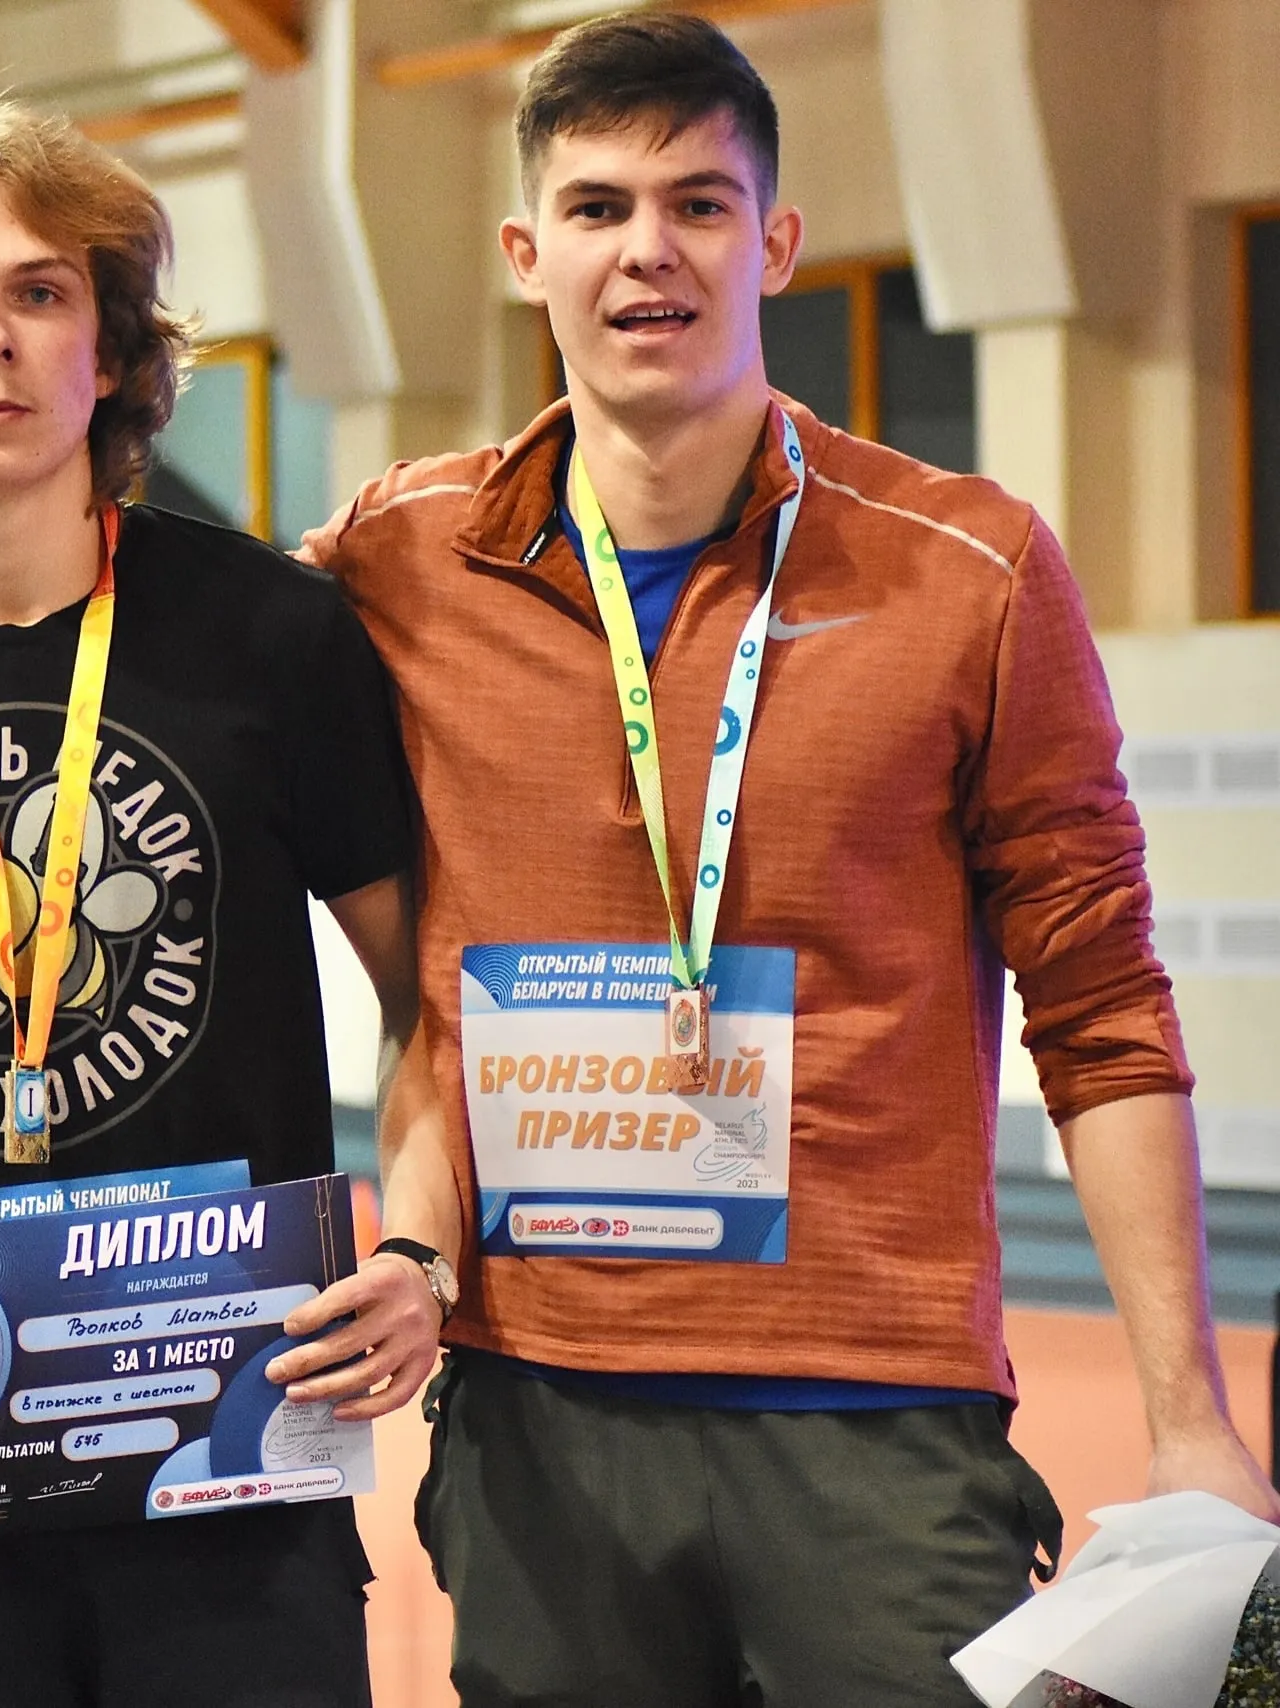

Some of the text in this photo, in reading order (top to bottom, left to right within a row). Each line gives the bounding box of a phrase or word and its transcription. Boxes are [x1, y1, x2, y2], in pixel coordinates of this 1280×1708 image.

[53, 739, 203, 883] ЕДОК
[518, 951, 606, 975] ОТКРЫТЫЙ
[512, 981, 588, 1000] БЕЛАРУСИ
[591, 981, 602, 1000] В
[0, 934, 204, 1134] ОЛОДОК
[516, 1110, 702, 1152] ПРИЗЕР
[713, 1152, 766, 1160] CHAMPIONSHIPS
[70, 1180, 171, 1210] ЧЕМПИОНАТ
[736, 1180, 759, 1189] 2023
[59, 1200, 267, 1280] ДИПЛОМ
[632, 1225, 715, 1236] БАНК ДАБРАБЫТ
[126, 1272, 209, 1294] НАГРАЖДАЕТСЯ
[67, 1301, 258, 1337] Волков Матвей
[112, 1336, 235, 1373] ЗА 1 МЕСТО
[130, 1383, 196, 1400] шестом
[309, 1453, 331, 1463] 2023
[273, 1477, 339, 1491] БАНК ДАБРАБЫТ
